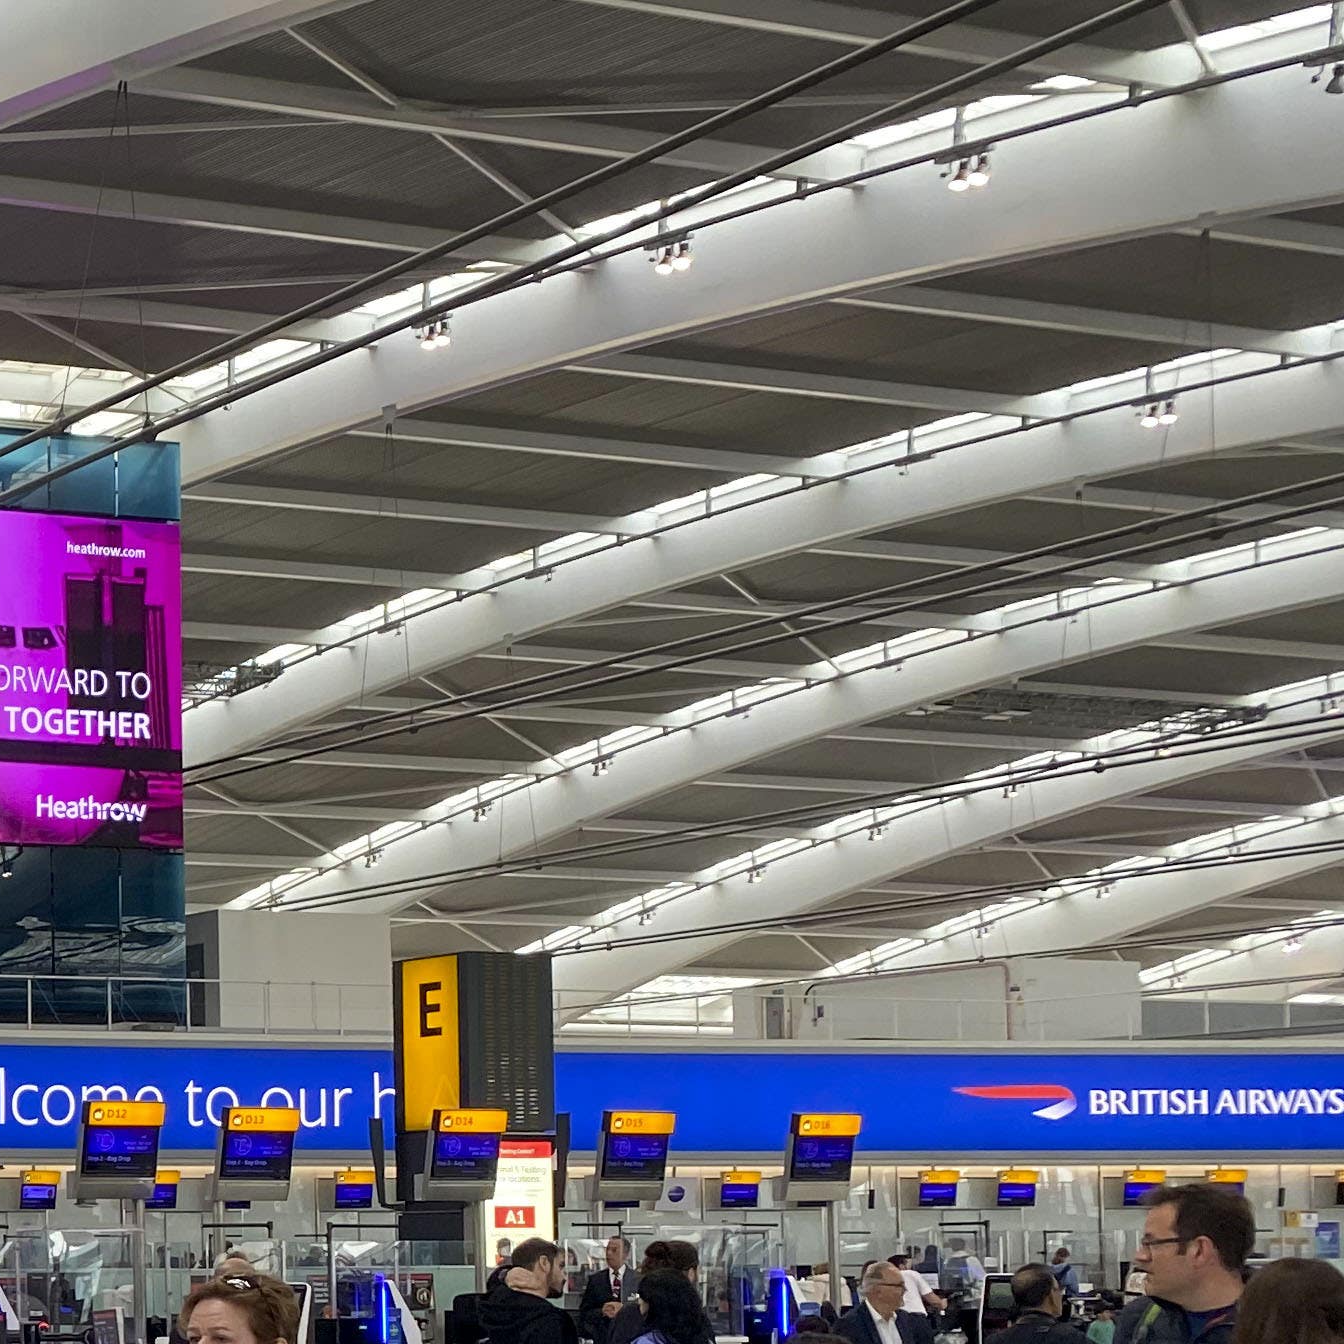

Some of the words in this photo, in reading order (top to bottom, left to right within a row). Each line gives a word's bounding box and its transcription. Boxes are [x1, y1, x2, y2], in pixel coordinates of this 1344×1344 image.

[66, 541, 146, 559] heathrow.com
[116, 671, 151, 699] TO
[4, 706, 151, 739] TOGETHER
[35, 794, 147, 823] Heathrow
[419, 981, 443, 1037] E
[107, 1109, 127, 1118] D12
[184, 1080, 240, 1128] to
[1089, 1088, 1209, 1115] BRITISH
[1215, 1088, 1344, 1115] AIRWAYS
[245, 1116, 265, 1125] D13
[455, 1116, 473, 1126] D14
[504, 1210, 525, 1225] A1
